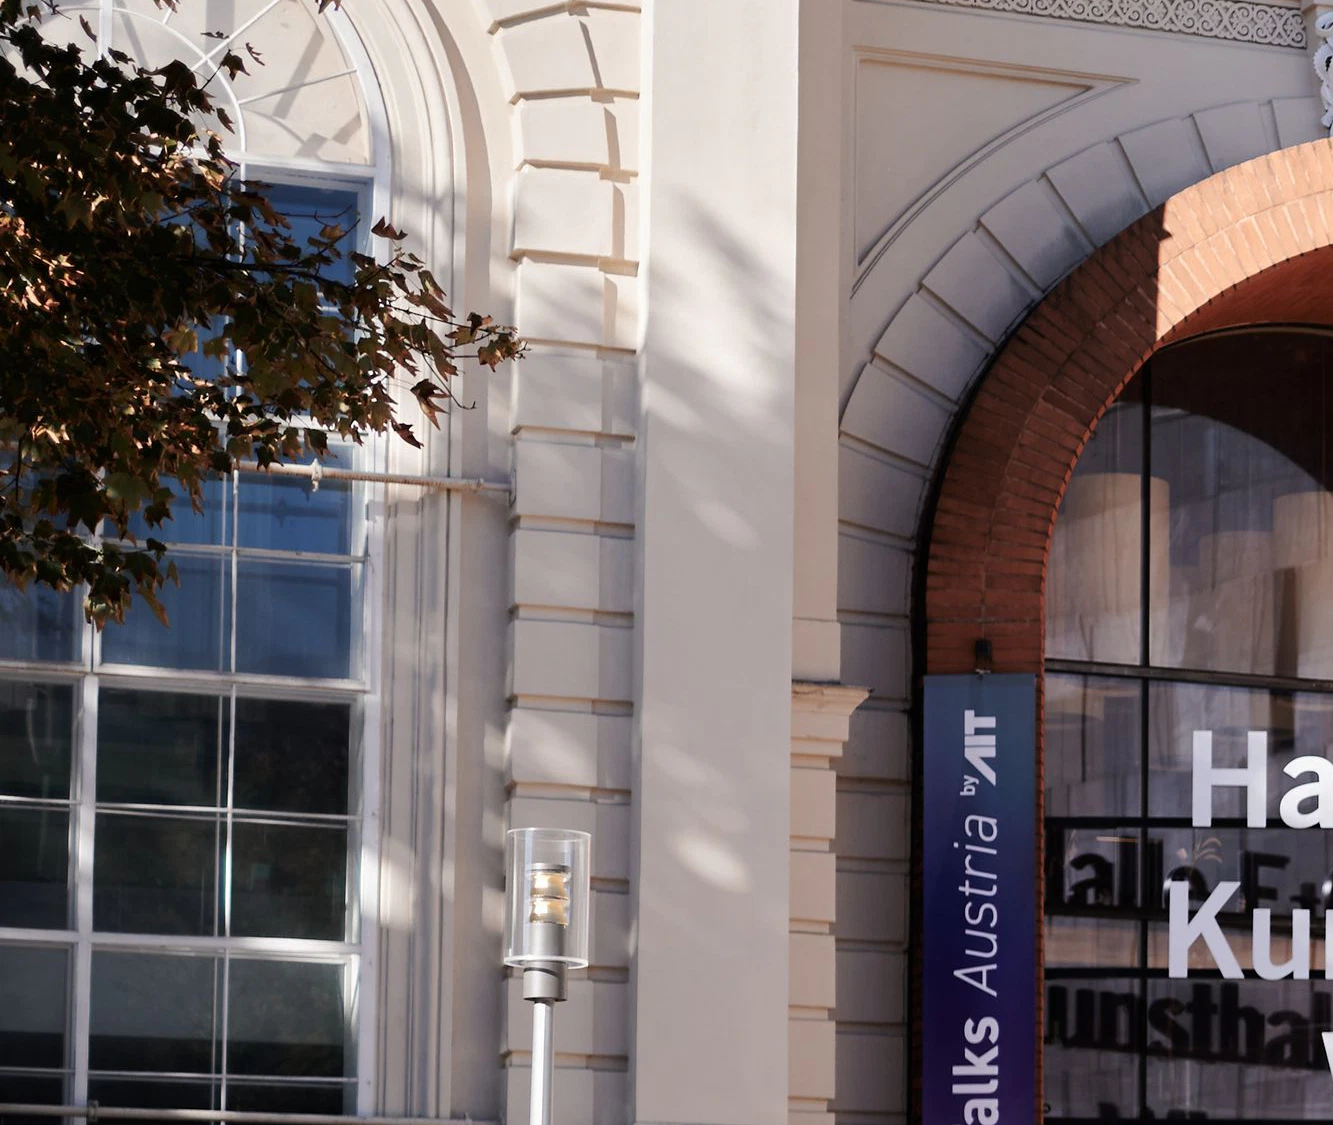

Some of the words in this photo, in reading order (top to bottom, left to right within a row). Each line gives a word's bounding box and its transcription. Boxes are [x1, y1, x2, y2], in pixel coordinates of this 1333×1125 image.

[960, 774, 980, 796] by
[964, 709, 996, 786] AIT
[953, 813, 998, 998] Austria
